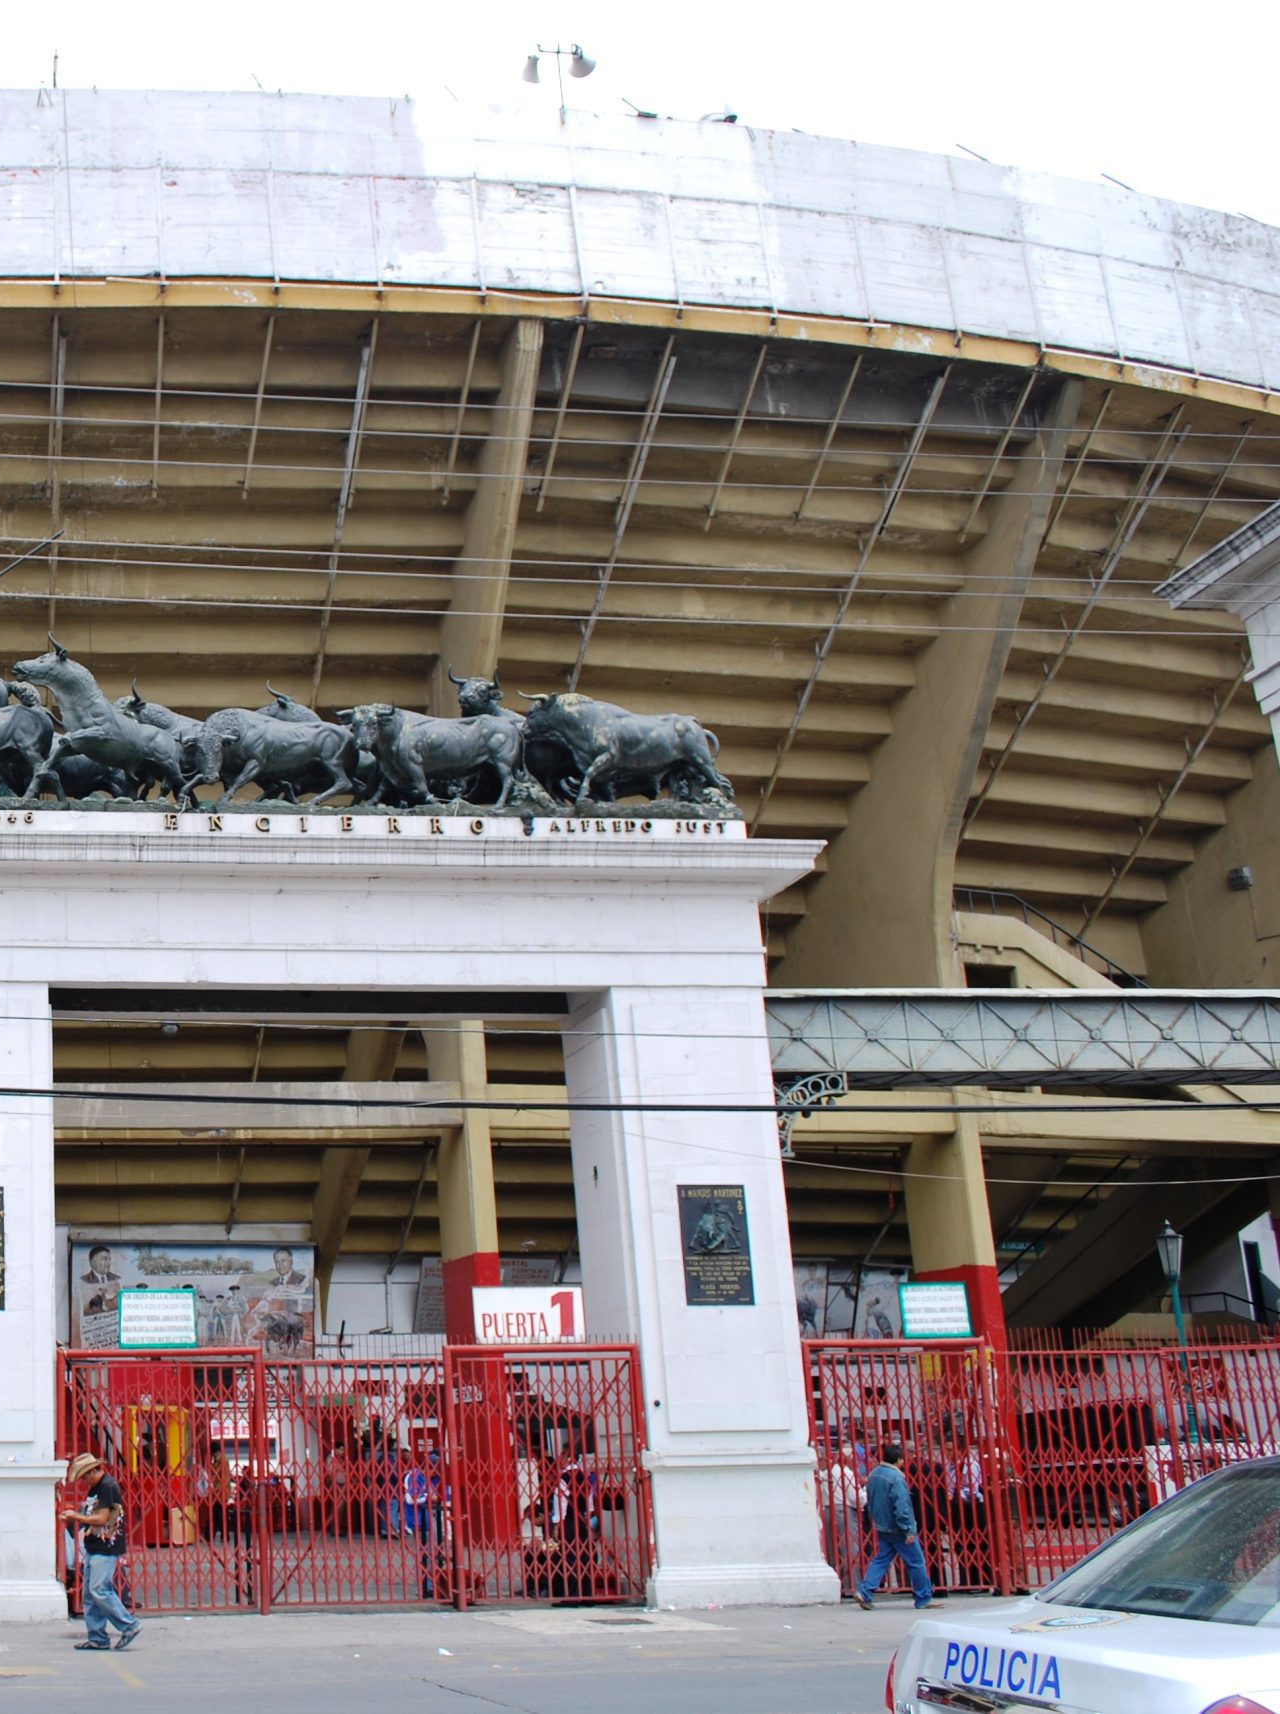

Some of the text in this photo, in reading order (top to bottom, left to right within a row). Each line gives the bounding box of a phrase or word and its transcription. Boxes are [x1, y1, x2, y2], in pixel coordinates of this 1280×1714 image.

[164, 812, 485, 835] ENCIERRO
[549, 818, 727, 835] ALFREDO JUST
[481, 1291, 575, 1338] PUERTA 1
[943, 1641, 1062, 1699] POLICIA
